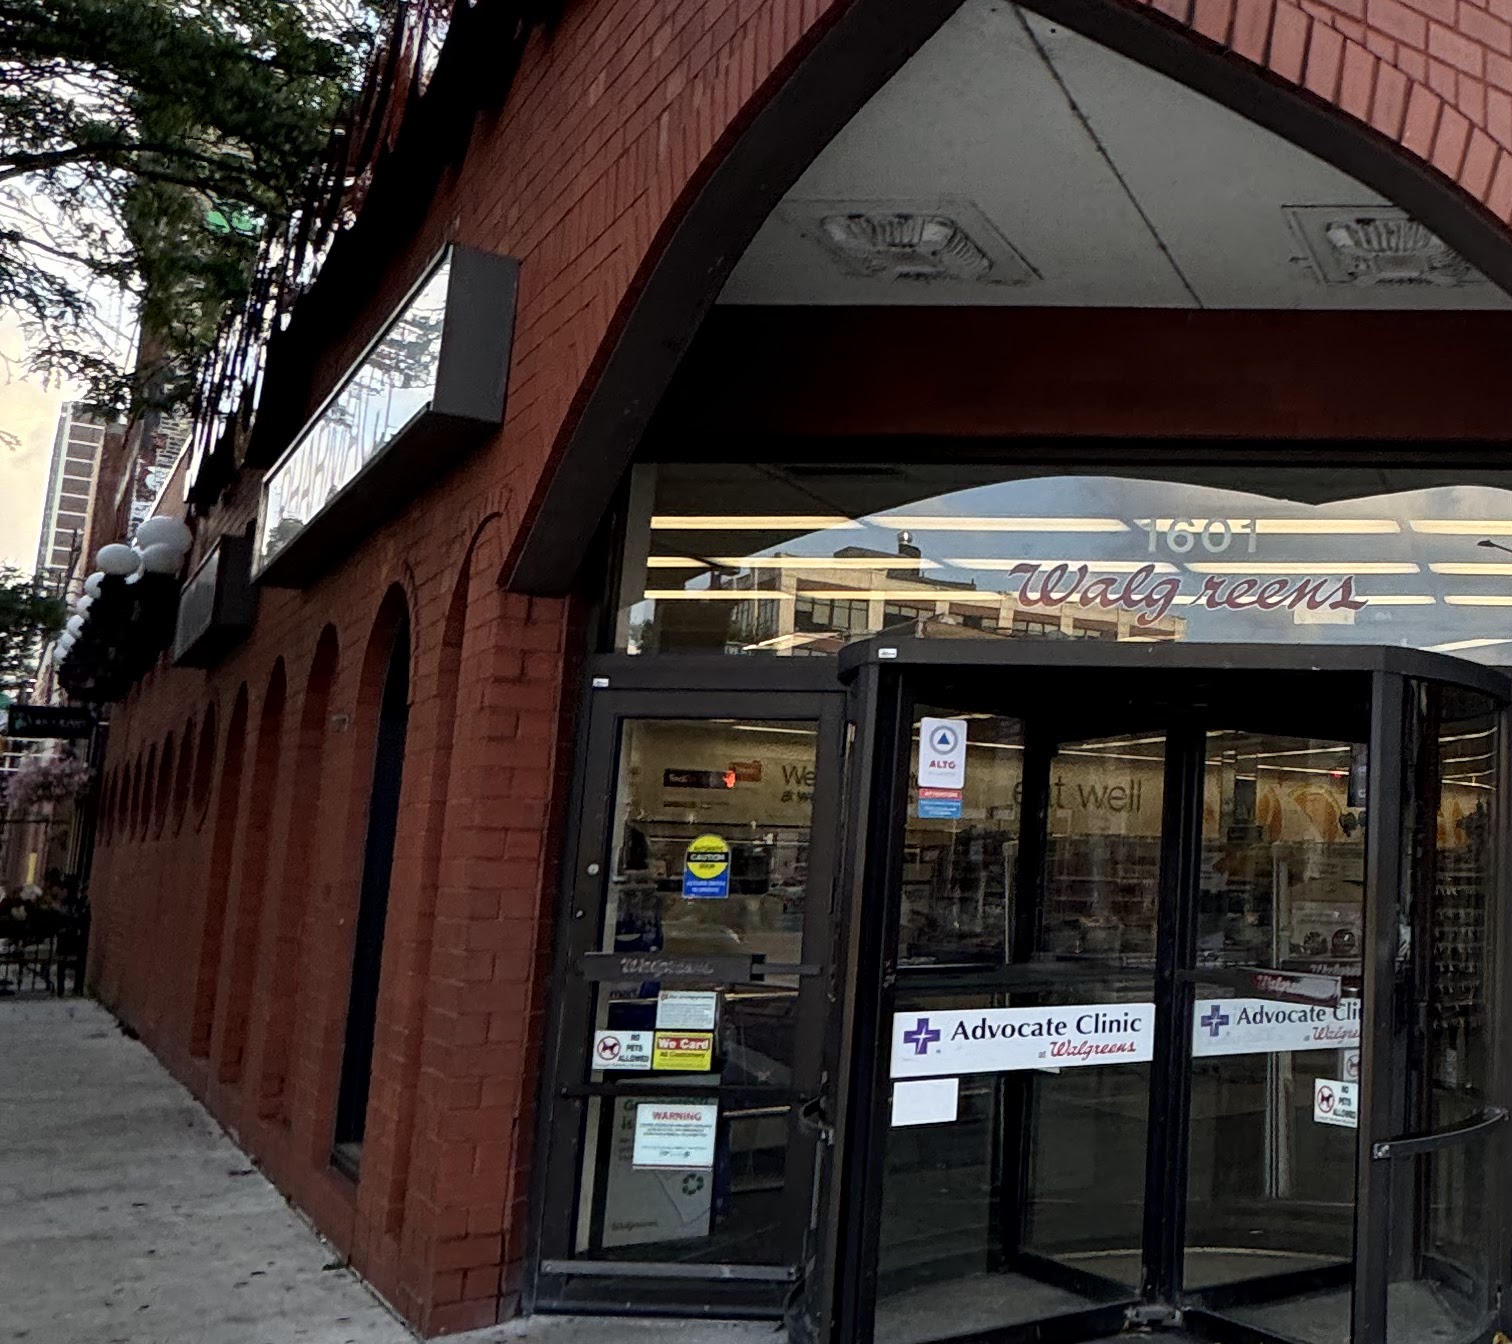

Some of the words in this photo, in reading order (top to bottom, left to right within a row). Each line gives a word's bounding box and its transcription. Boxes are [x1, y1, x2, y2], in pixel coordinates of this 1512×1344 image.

[1142, 517, 1257, 554] 1601
[929, 759, 957, 770] ALTO
[1077, 778, 1142, 814] well
[1236, 1005, 1326, 1025] Advocate
[1333, 1002, 1361, 1021] Cli
[951, 1018, 1067, 1040] Advocate
[1076, 1012, 1142, 1035] Clinic
[658, 1038, 677, 1049] We
[680, 1038, 709, 1050] Card
[1050, 1040, 1136, 1061] Walgreens
[652, 1111, 702, 1122] WARNING
